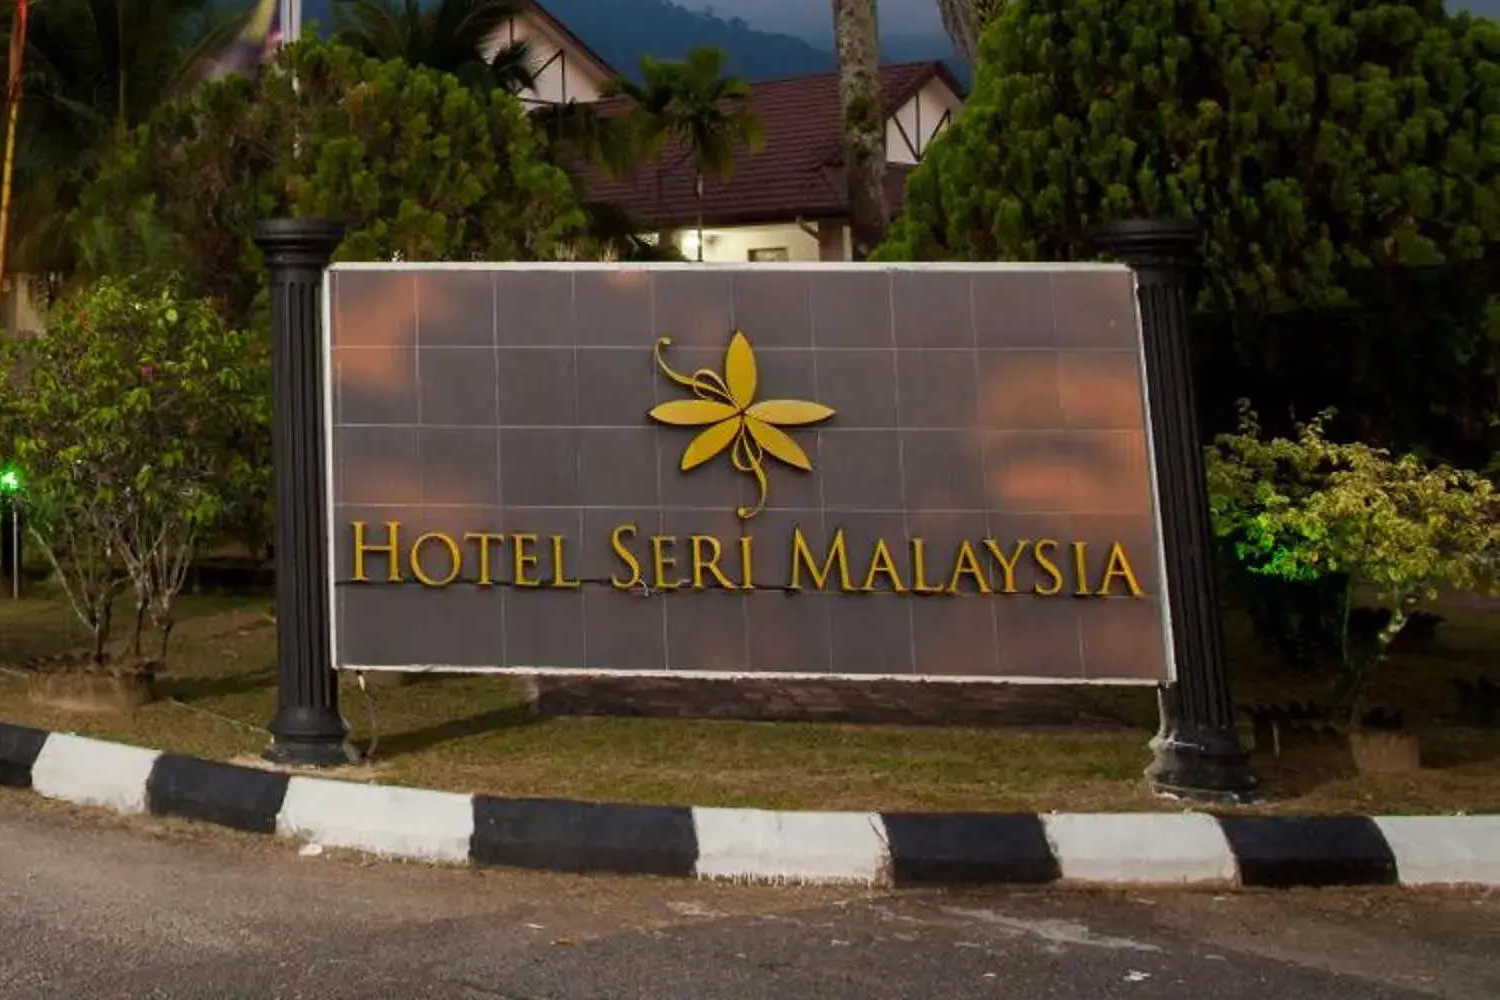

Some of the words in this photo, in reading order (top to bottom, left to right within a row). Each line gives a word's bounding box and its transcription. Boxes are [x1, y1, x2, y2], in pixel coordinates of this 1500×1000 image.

[350, 520, 581, 587] HOTEL
[610, 524, 755, 590] SERI
[788, 526, 1143, 596] MALAYSIA
